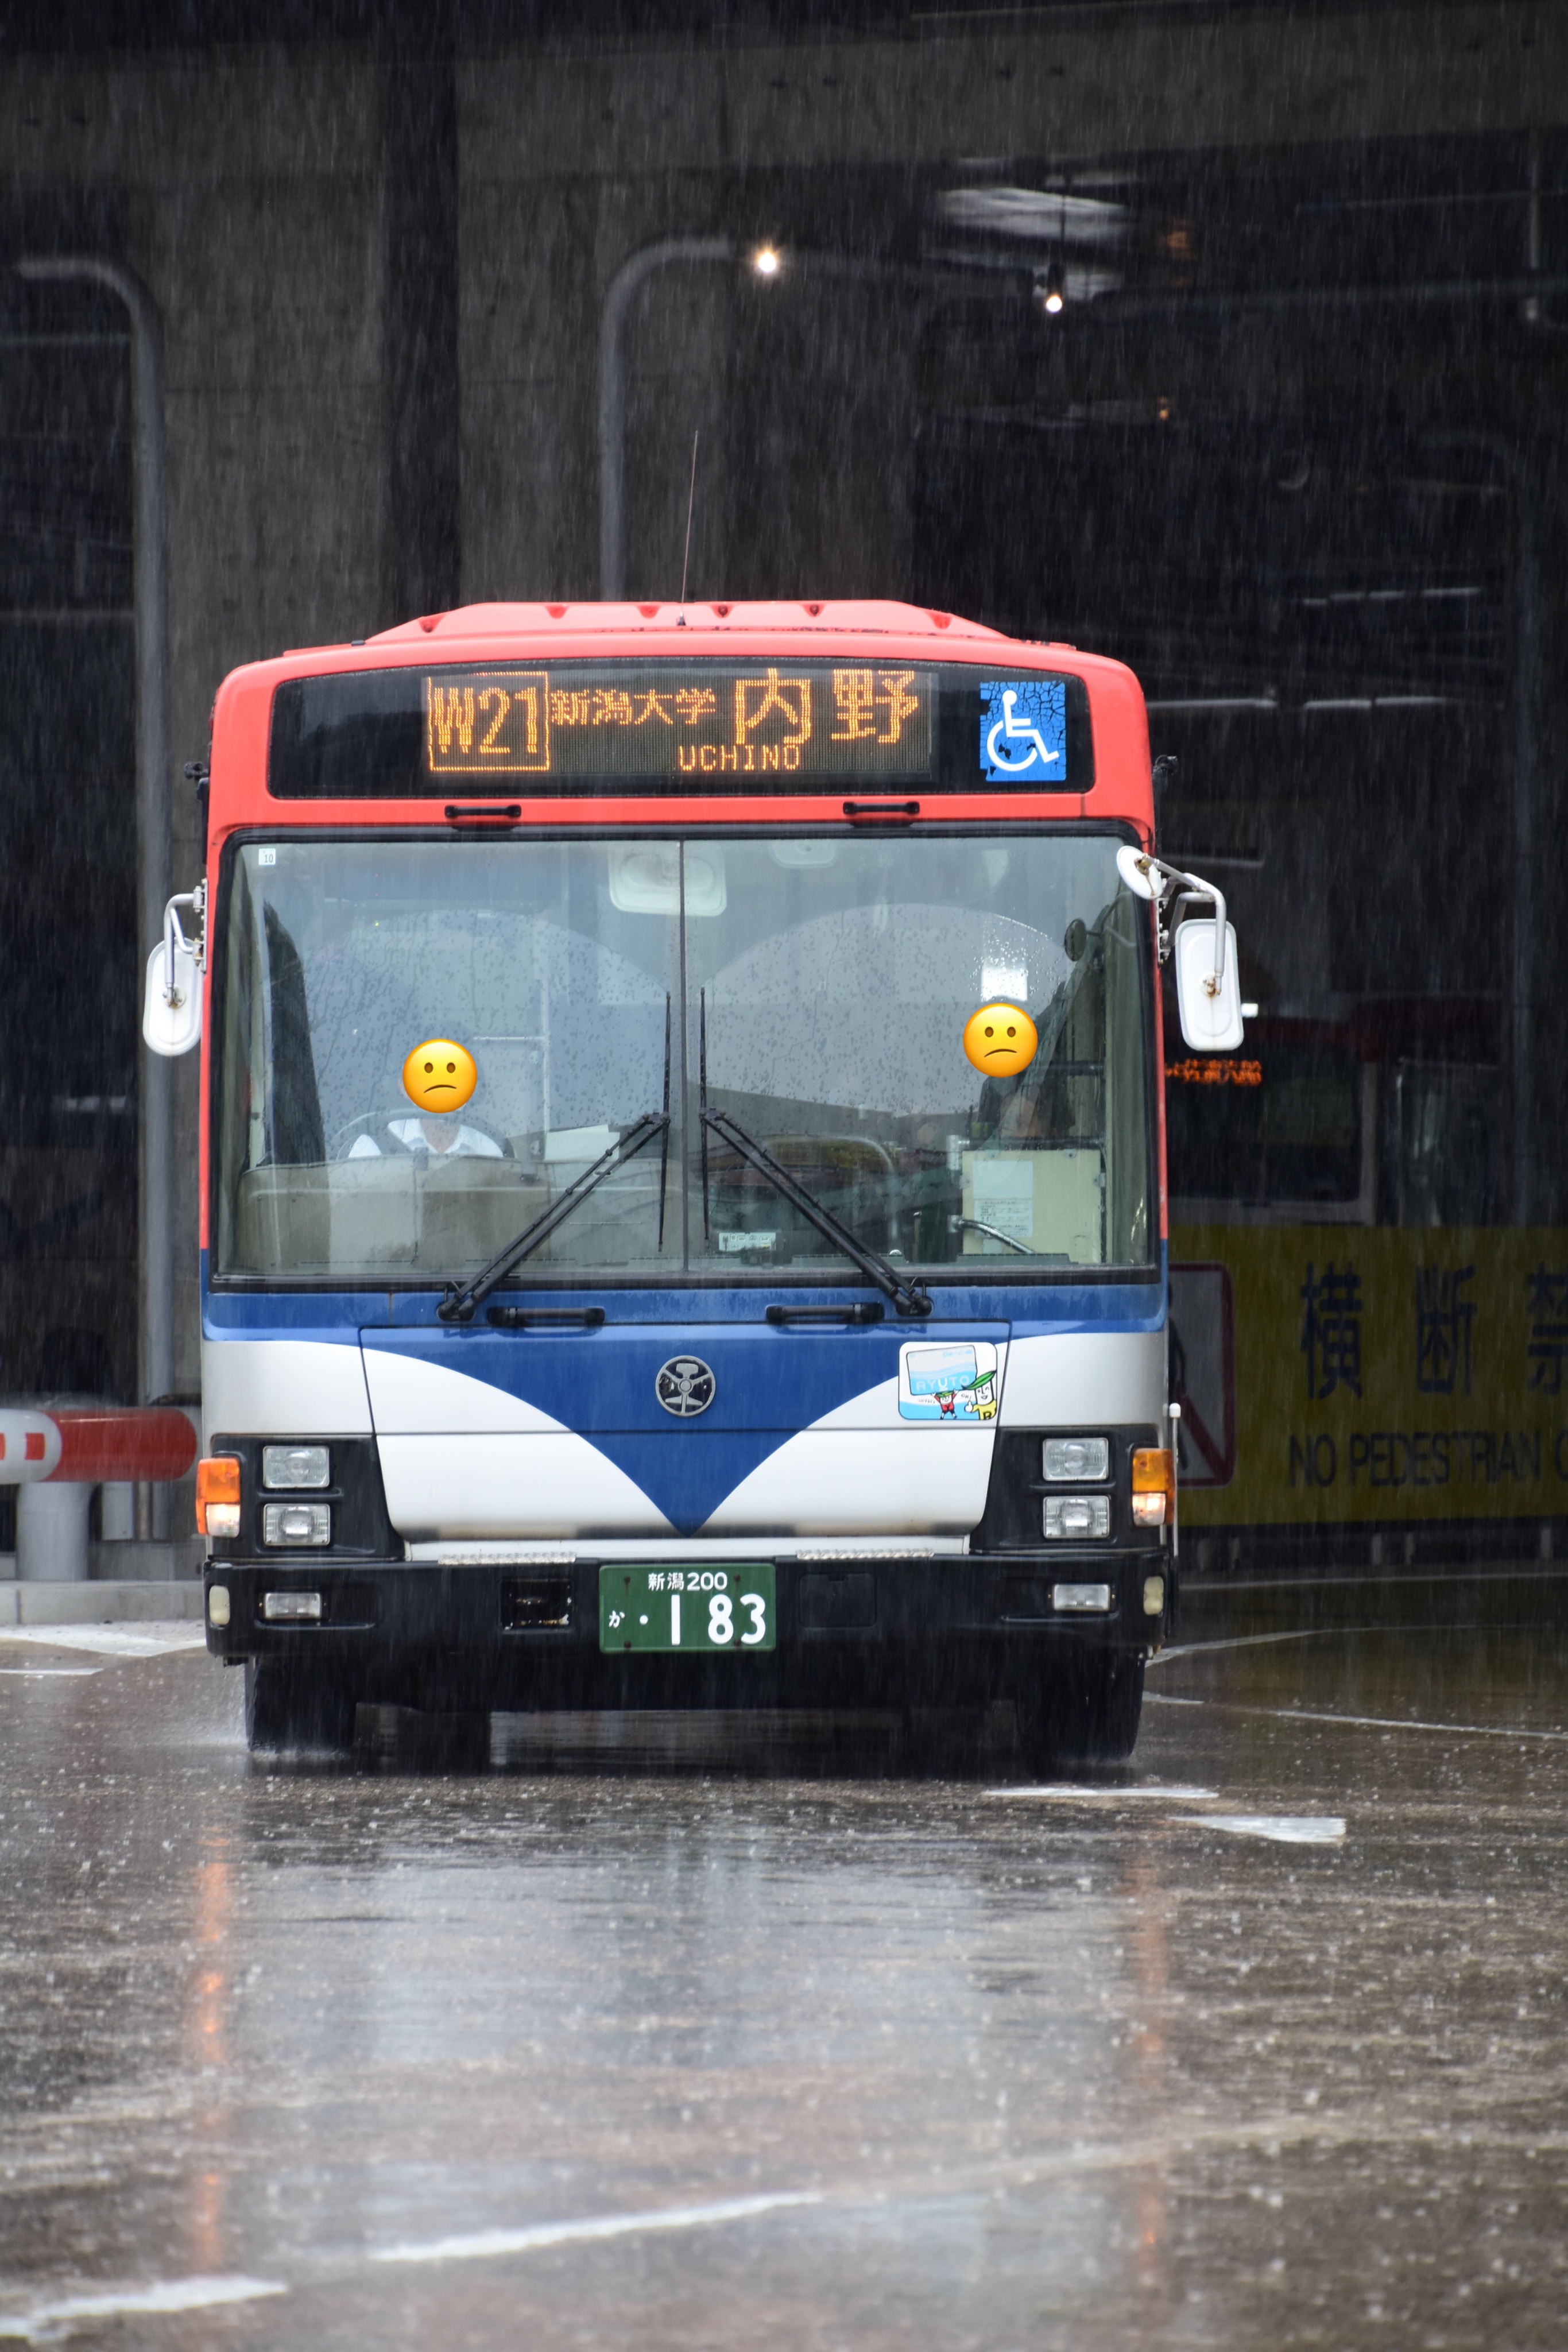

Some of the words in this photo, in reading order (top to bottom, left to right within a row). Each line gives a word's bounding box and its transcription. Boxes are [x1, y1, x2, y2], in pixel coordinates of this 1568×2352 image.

[434, 687, 537, 753] W21
[551, 688, 716, 726] 新潟大学
[679, 745, 800, 771] UCHINO
[264, 853, 273, 863] 10
[916, 1375, 970, 1392] RYUTO
[1289, 1433, 1337, 1487] NO
[1349, 1429, 1542, 1486] PEDESTRIAN
[609, 1610, 625, 1628] か
